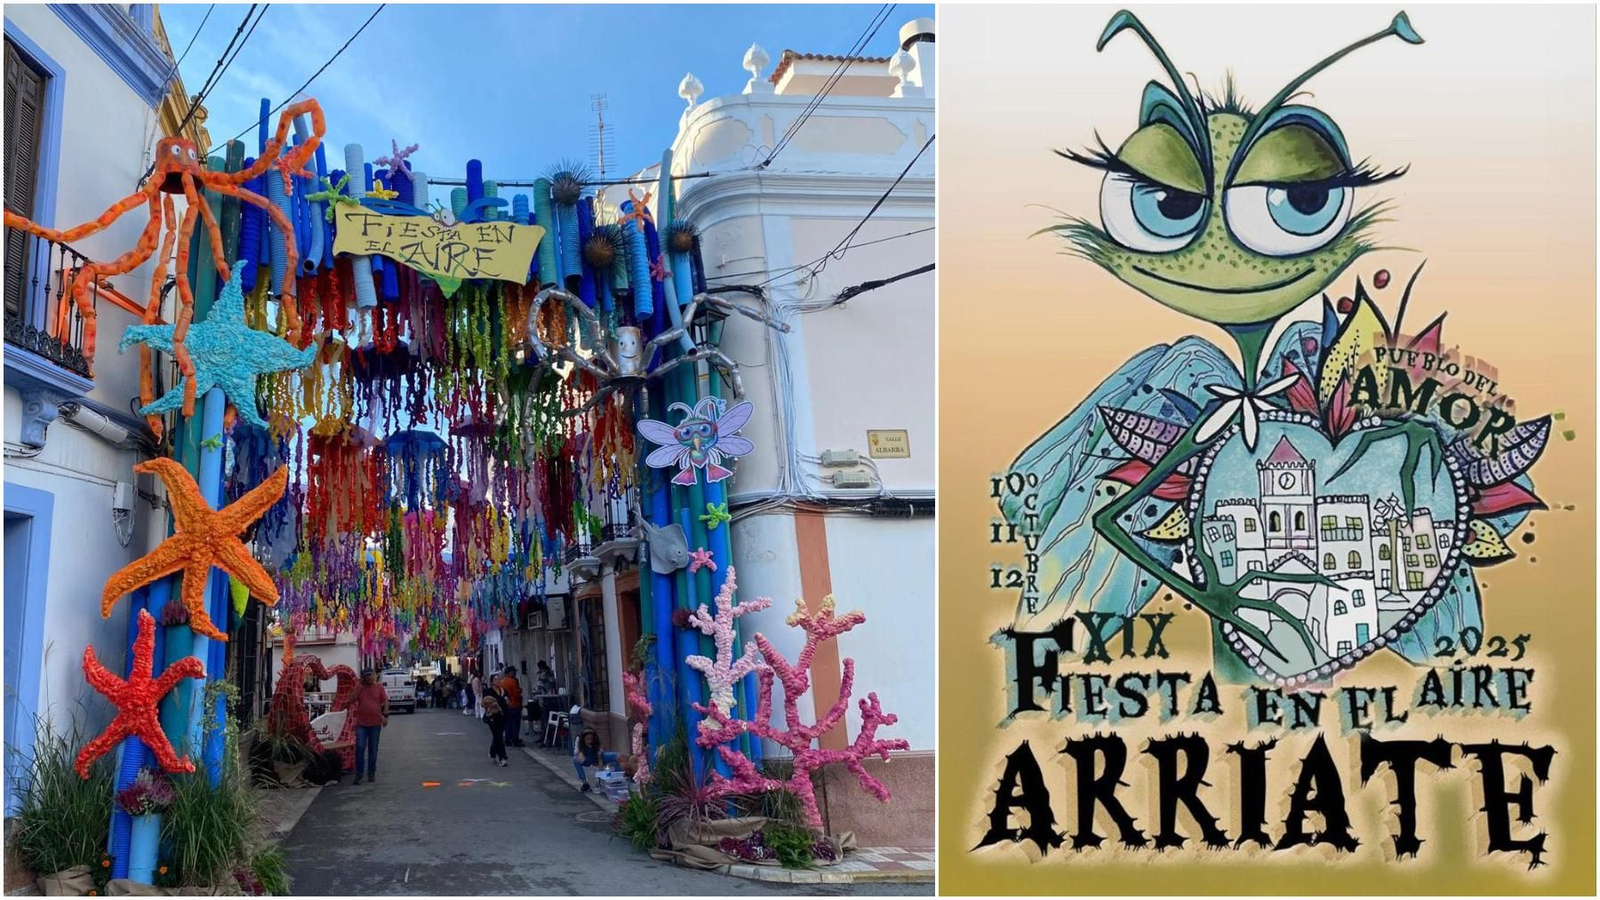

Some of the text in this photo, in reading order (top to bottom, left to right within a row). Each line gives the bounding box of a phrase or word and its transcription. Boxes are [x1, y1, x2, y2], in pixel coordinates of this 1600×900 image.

[364, 240, 396, 254] EL
[476, 224, 515, 244] EN
[1373, 347, 1500, 397] PUEBLO DEL
[1347, 364, 1516, 460] AMOR
[990, 472, 1025, 498] 10
[990, 523, 1018, 543] 11
[1024, 472, 1040, 615] OCTUBRE
[990, 568, 1024, 588] 12
[1074, 611, 1175, 664] XIX
[1434, 626, 1532, 661] 2025
[1001, 618, 1224, 719] FIESTA
[1251, 685, 1326, 729] EN
[1340, 685, 1408, 730] EL
[968, 730, 1558, 872] ARRIATE
